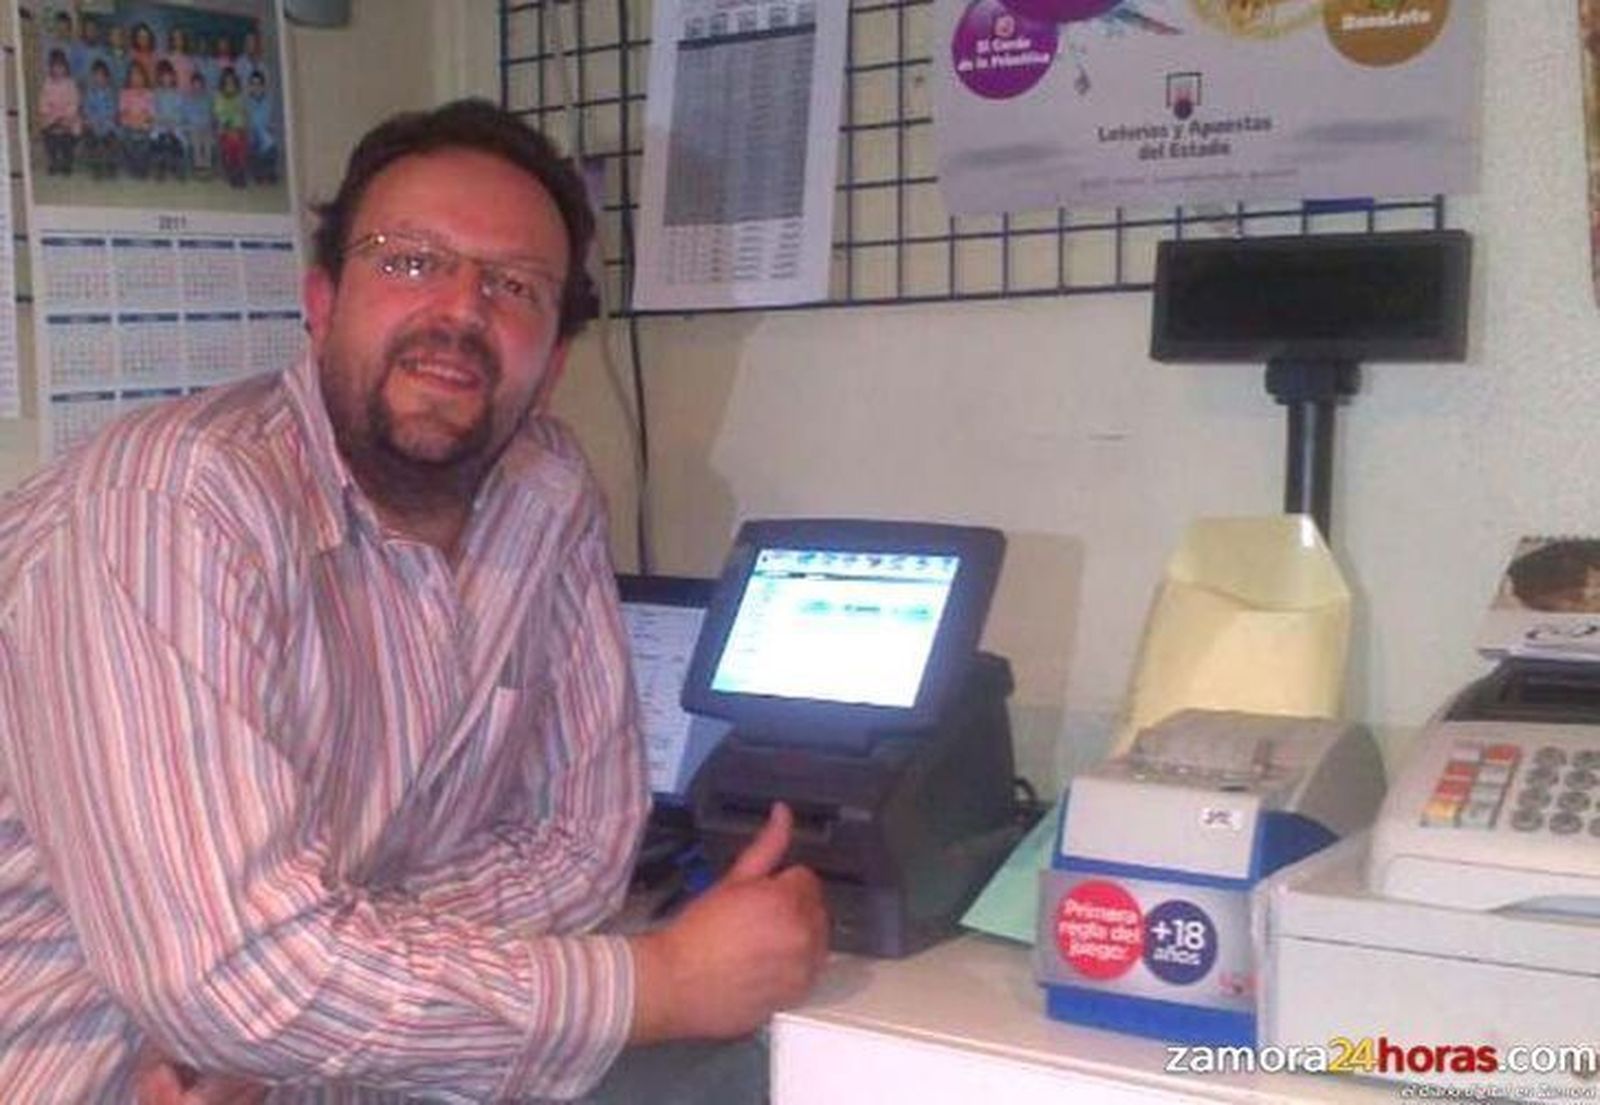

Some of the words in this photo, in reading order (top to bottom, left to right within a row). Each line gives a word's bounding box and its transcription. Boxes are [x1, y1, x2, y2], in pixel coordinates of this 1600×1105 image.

[1139, 145, 1165, 160] del
[1169, 142, 1230, 158] Estado
[1063, 898, 1138, 924] Primera
[1059, 921, 1109, 942] regla
[1110, 926, 1142, 944] del
[1150, 919, 1206, 950] +18
[1152, 946, 1201, 966] años
